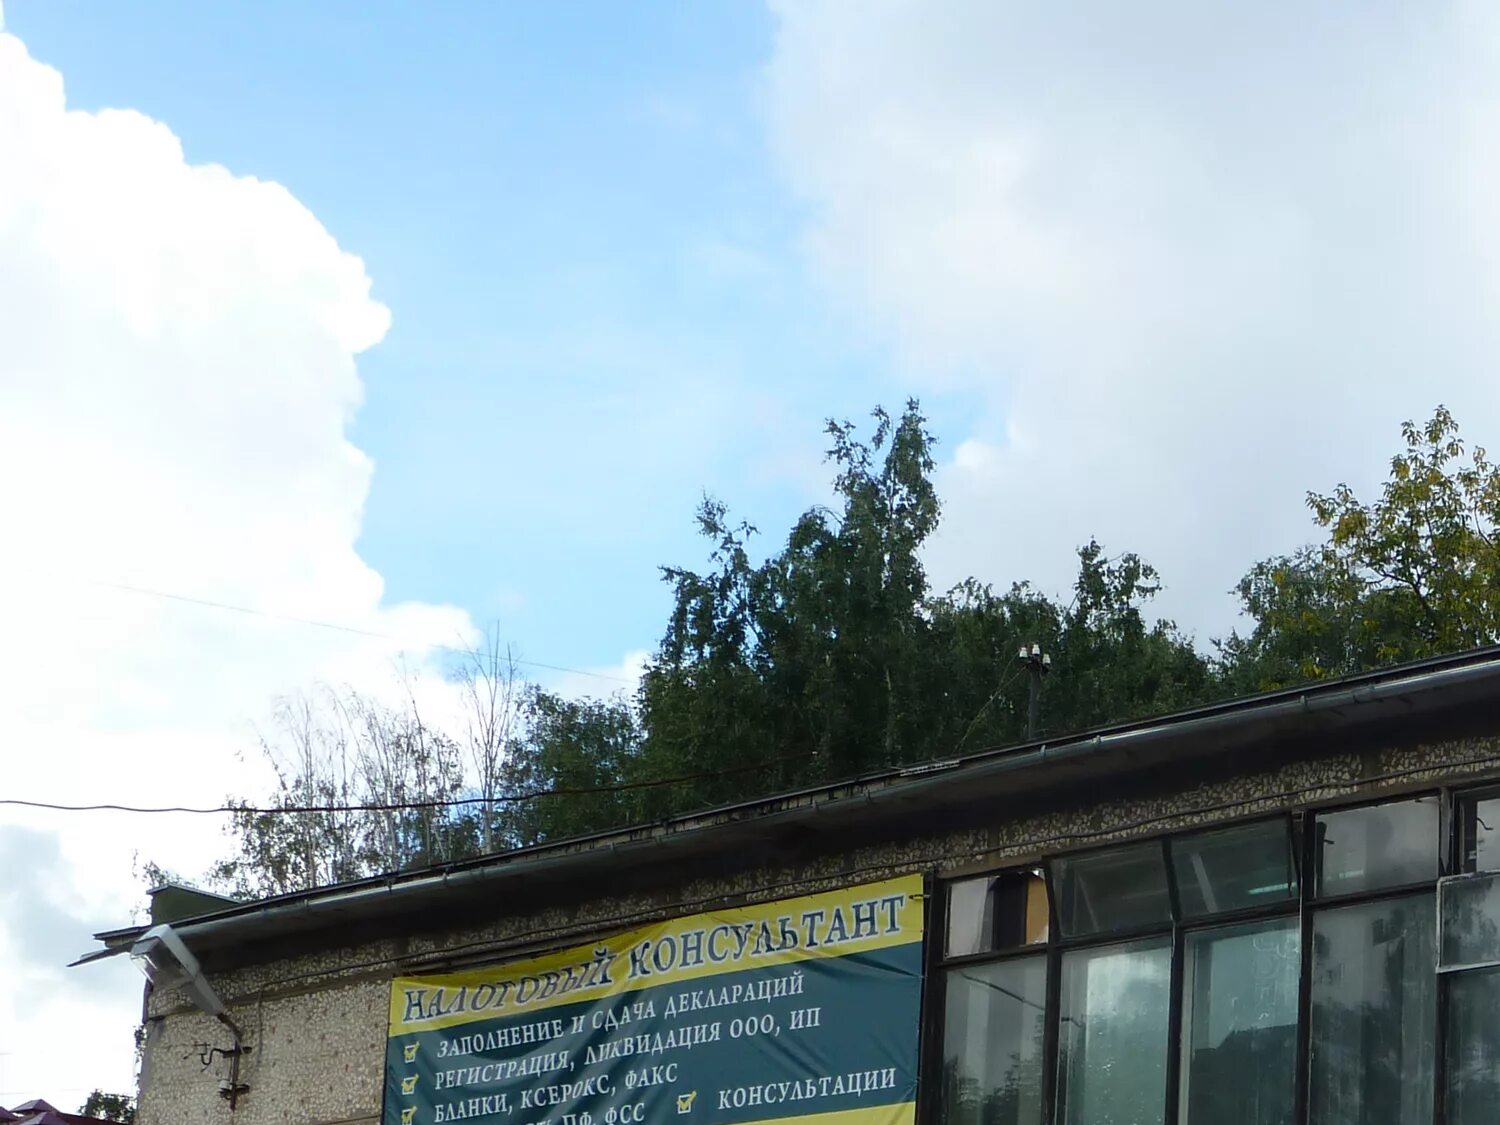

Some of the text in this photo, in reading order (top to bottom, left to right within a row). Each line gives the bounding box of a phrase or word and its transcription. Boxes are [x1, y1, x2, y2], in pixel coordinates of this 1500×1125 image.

[402, 895, 905, 1023] НАЛОГОВЫЙ КОНСУЛЬТАНТ
[434, 1007, 821, 1091] РЕГИСТРАЦИЯ, ЛИКВИДАЦИЯ ООО, ИП
[437, 970, 804, 1059] ЗАПОЛНЕНИЕ И СДАЧА ДЕКЛАРАЦИЙ
[434, 1063, 678, 1123] БЛАНКИ, КСЕРОКС, ФАКС
[718, 1068, 896, 1110] КОНСУЛЬТАЦИИ
